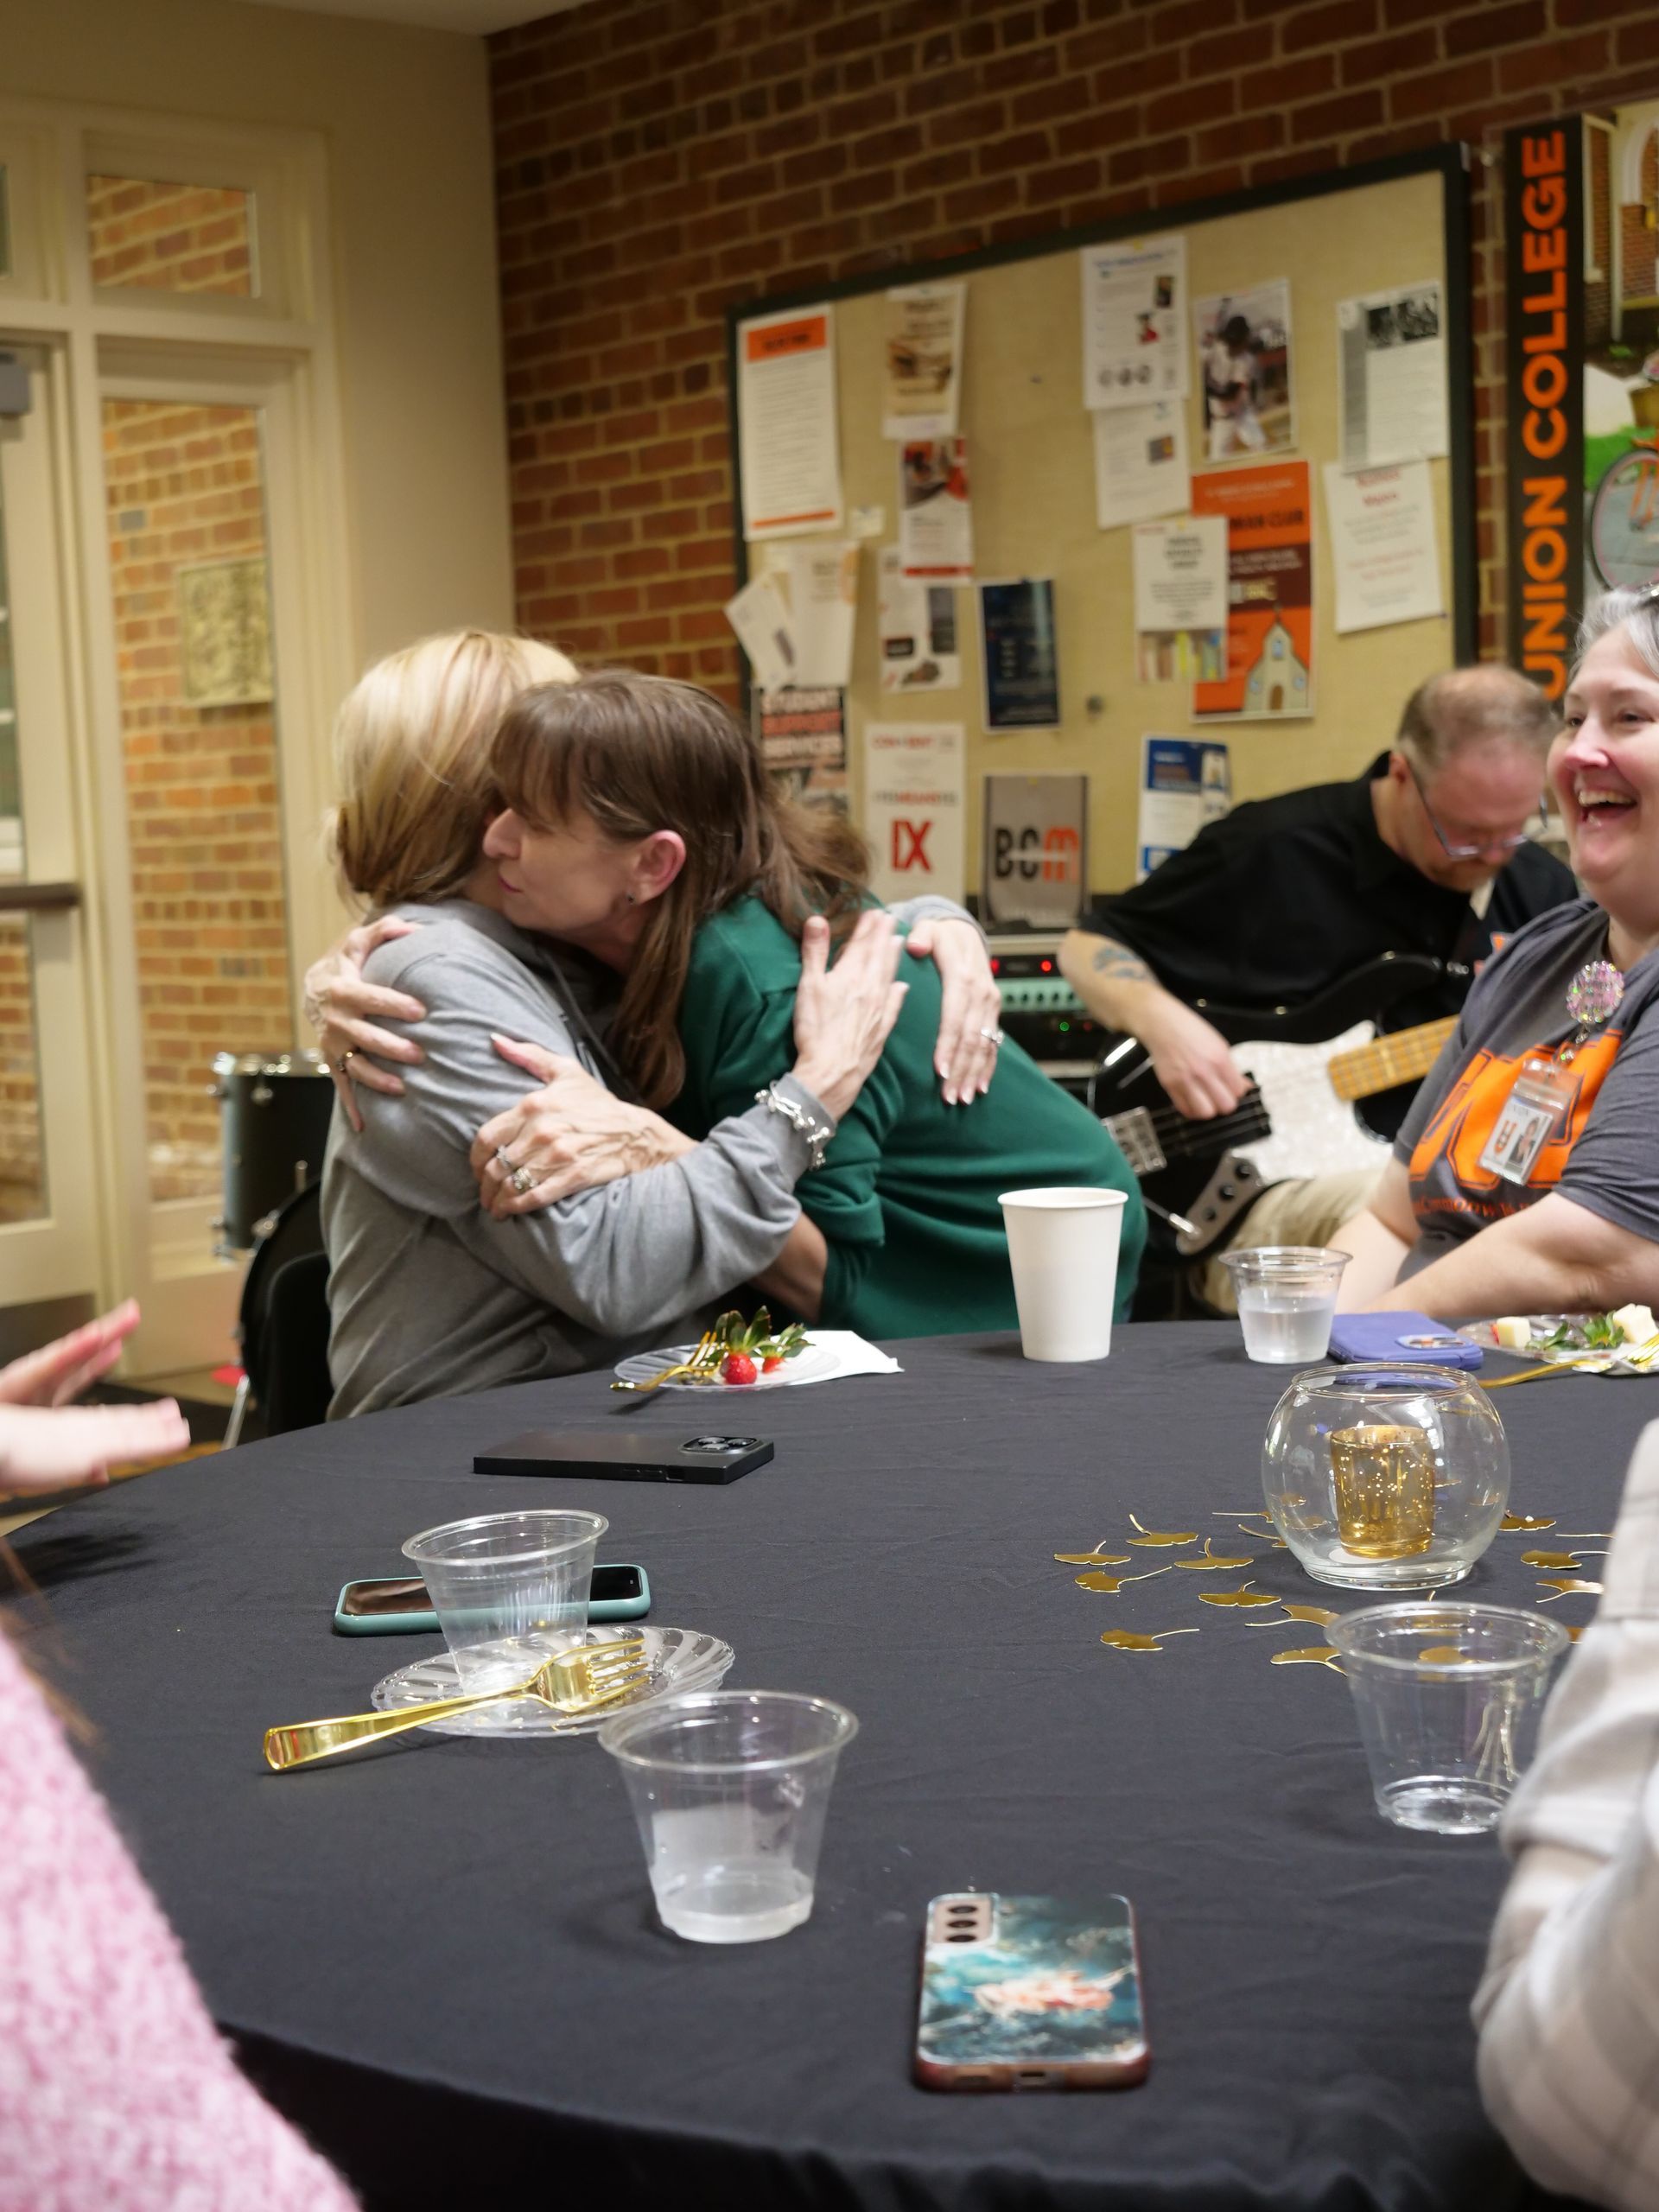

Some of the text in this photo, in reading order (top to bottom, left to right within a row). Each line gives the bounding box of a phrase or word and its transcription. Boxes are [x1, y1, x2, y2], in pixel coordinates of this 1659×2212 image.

[1522, 130, 1568, 701] UNION COLLEGE
[892, 818, 931, 874] IX
